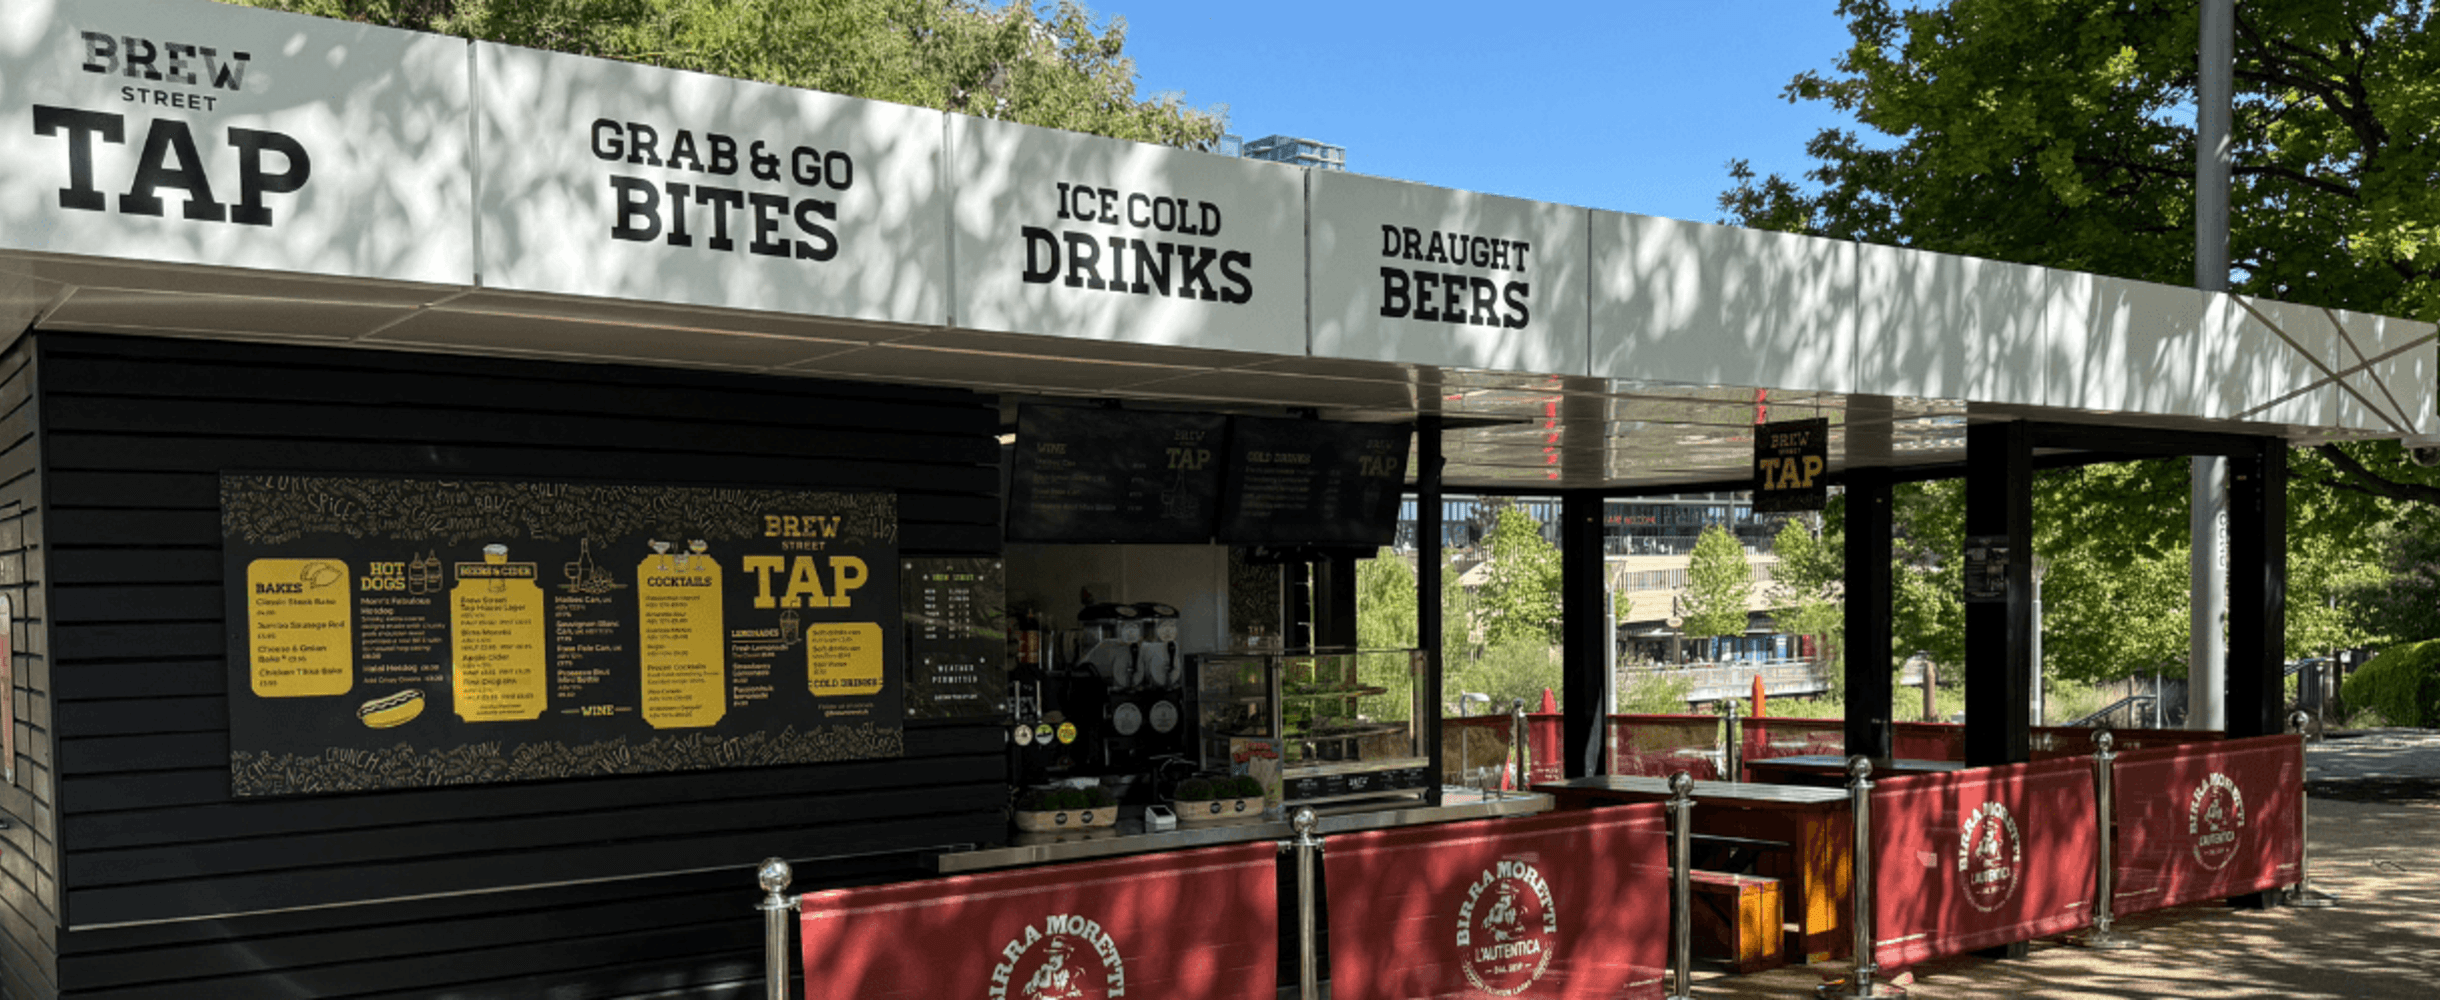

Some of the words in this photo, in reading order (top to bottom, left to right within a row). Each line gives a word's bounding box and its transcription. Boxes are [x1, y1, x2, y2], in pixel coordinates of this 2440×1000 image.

[80, 30, 251, 92] BREW
[121, 85, 217, 113] STREET
[32, 103, 312, 227] TAP
[591, 118, 739, 178] GRAB
[750, 139, 781, 182] &
[791, 146, 853, 192] GO
[609, 174, 839, 262] BITES
[1057, 181, 1119, 226] ICE
[1128, 191, 1221, 238] COLD
[1022, 225, 1253, 305] DRINKS
[1381, 223, 1531, 273] DRAUGHT
[1380, 266, 1530, 330] BEERS
[1036, 442, 1067, 454] WINE
[1770, 431, 1810, 448] BREW
[1165, 447, 1210, 470] TAP
[1358, 454, 1398, 477] TAP
[1760, 455, 1823, 490] TAP
[764, 515, 841, 537] BREW
[781, 541, 825, 551] STREET
[361, 577, 406, 591] DOGS
[370, 562, 405, 576] HOT
[647, 576, 713, 587] COCKTAILS
[743, 556, 868, 608] TAP
[256, 582, 303, 594] BAKES
[581, 704, 614, 716] WINE
[2189, 778, 2209, 834] BIRRA
[2209, 772, 2245, 827] MORETTI
[1958, 807, 1982, 872] BIRRA
[1982, 801, 2021, 862] MORETTI
[1456, 869, 1496, 946] BIRRA
[1496, 861, 1557, 934] MORETTI
[988, 924, 1043, 1000] IRRA
[1045, 913, 1126, 998] MORETTI
[1475, 938, 1541, 963] L'AUTENTICA
